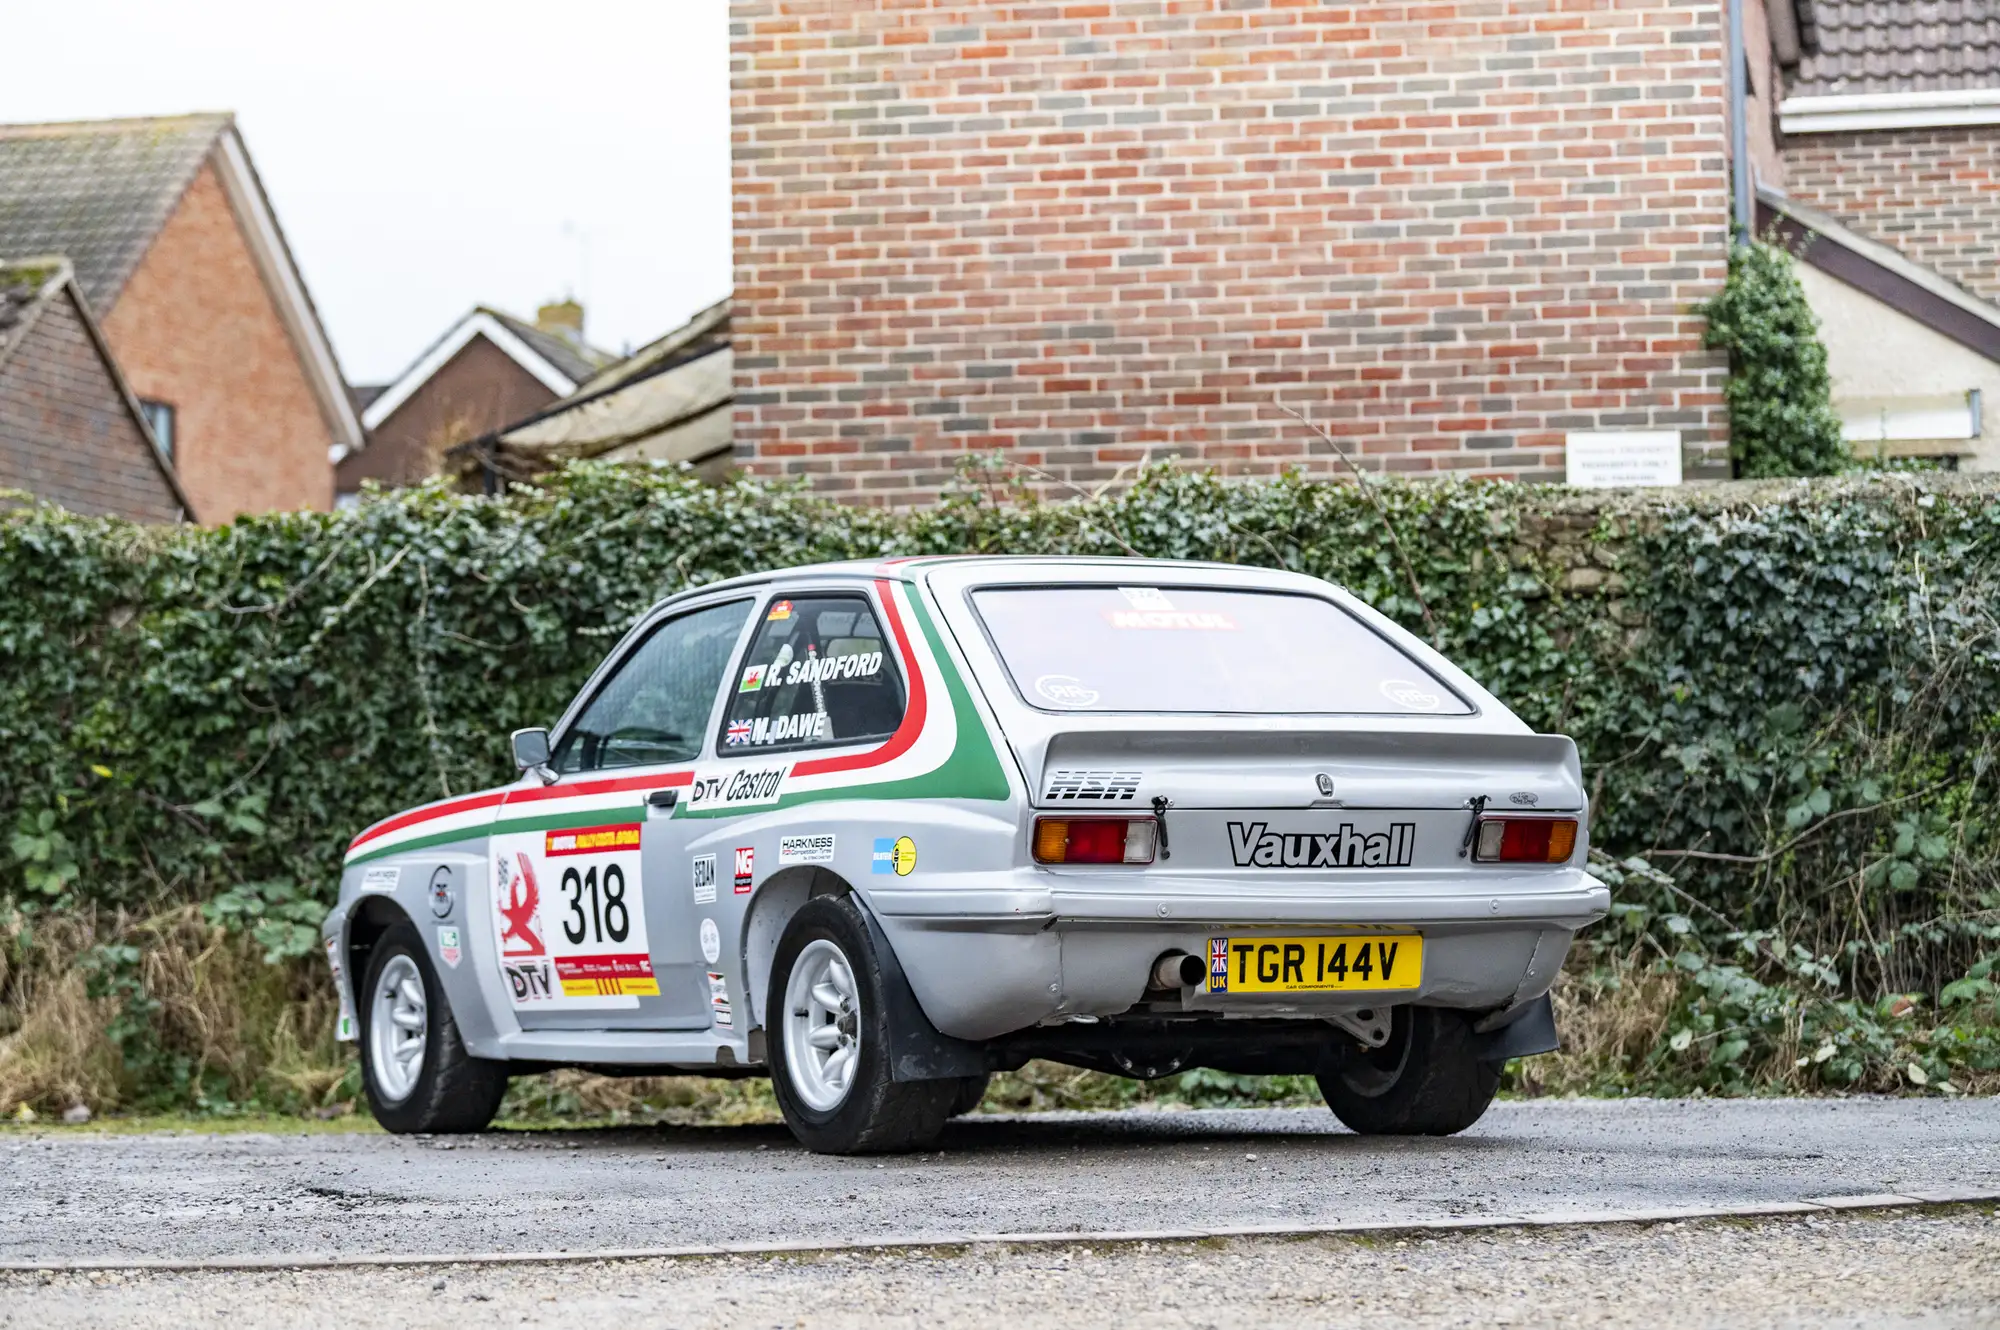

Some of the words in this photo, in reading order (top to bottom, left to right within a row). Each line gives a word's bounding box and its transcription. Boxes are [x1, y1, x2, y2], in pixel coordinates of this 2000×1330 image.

[1112, 609, 1235, 630] MOTUL
[764, 663, 783, 687] R.
[786, 651, 883, 685] SANDFORD
[751, 716, 770, 742] M.
[775, 711, 828, 740] DAWE
[692, 777, 728, 802] DTV
[726, 766, 787, 802] Castrol
[782, 836, 833, 850] HARKNESS
[1226, 821, 1416, 868] Vauxhall
[694, 859, 716, 888] SEDAN
[735, 849, 754, 875] NG
[560, 863, 630, 945] 318
[1233, 944, 1305, 984] TGR
[1316, 942, 1399, 983] 144V
[504, 964, 551, 999] DTV
[1211, 975, 1228, 989] UK
